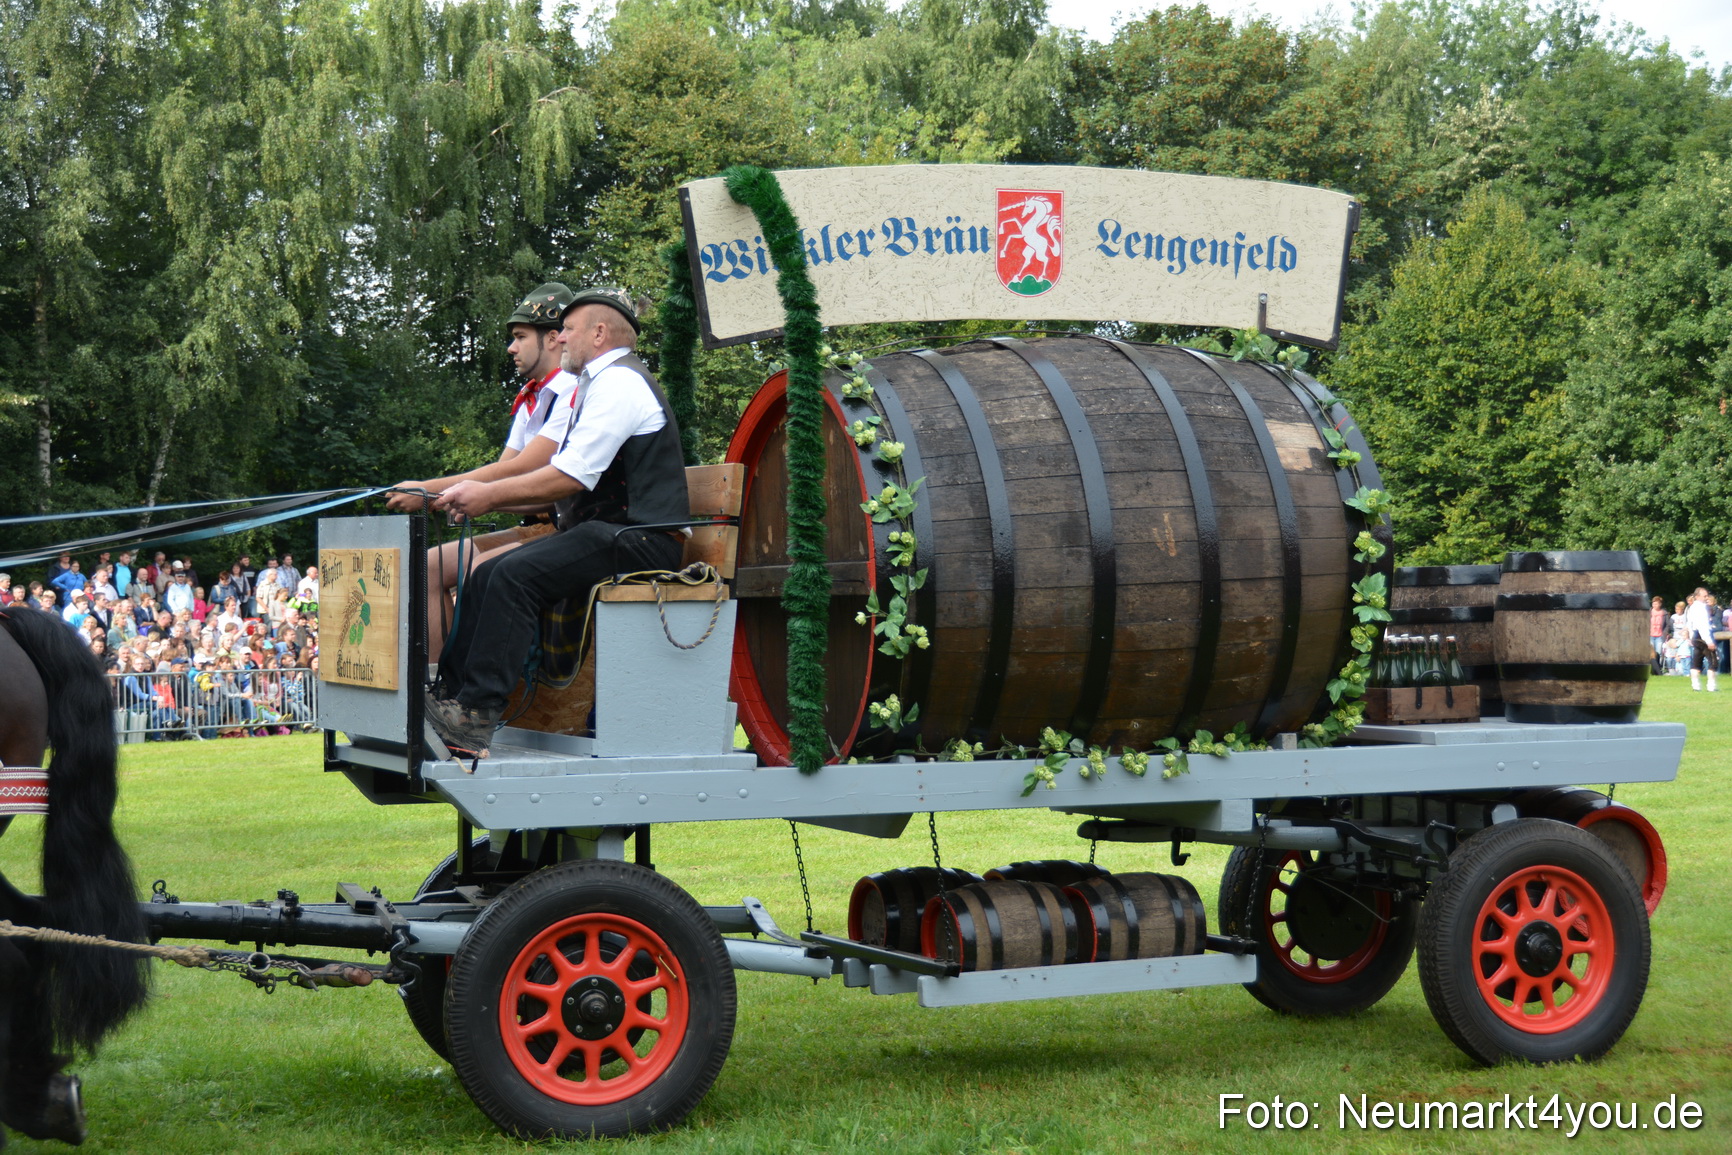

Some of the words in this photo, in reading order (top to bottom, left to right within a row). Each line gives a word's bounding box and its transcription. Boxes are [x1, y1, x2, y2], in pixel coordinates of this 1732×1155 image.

[700, 224, 876, 283] Wikler
[881, 216, 991, 256] Bräu
[1095, 218, 1297, 280] Lengenfeld
